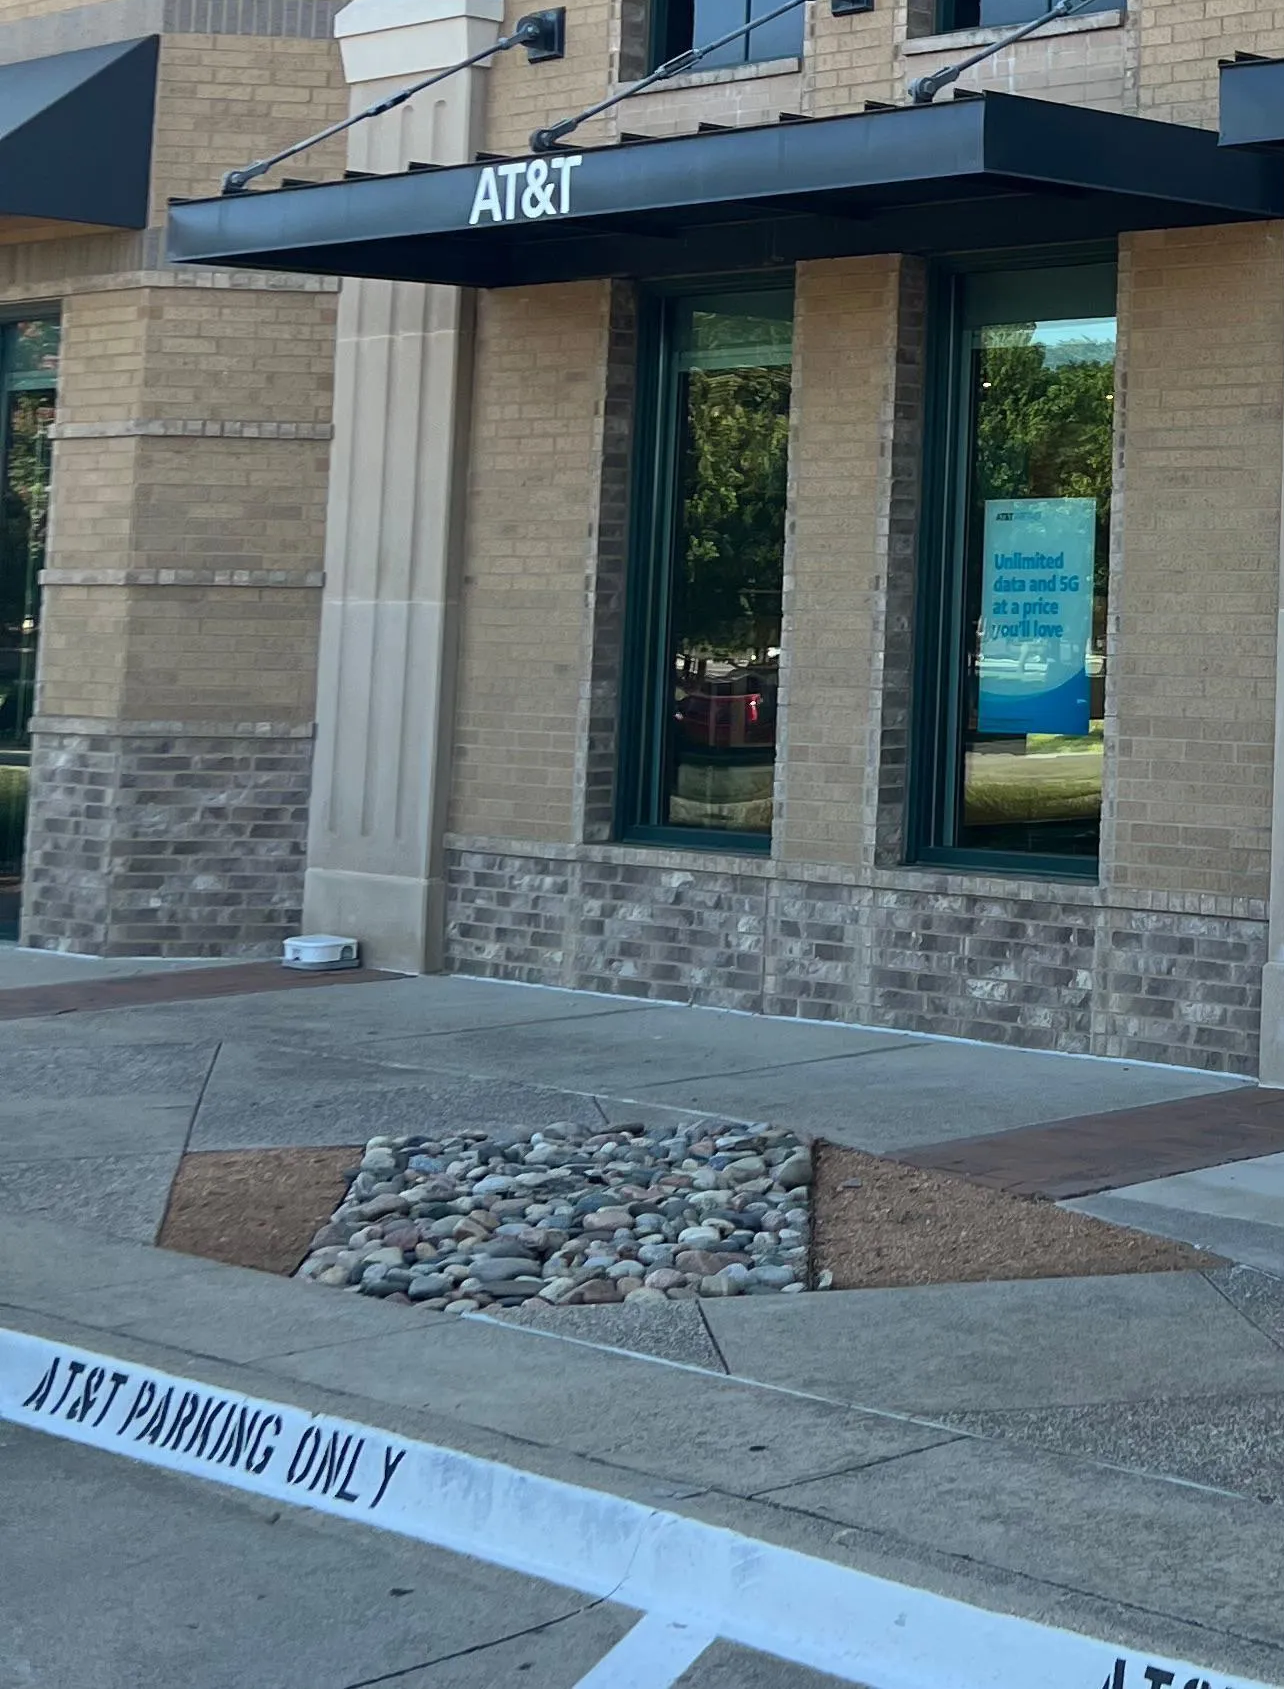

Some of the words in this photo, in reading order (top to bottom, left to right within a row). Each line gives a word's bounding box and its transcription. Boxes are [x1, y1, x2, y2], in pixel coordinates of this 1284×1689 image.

[468, 155, 583, 225] AT&T
[994, 551, 1064, 570] Unlimited
[993, 575, 1026, 592] data
[1029, 574, 1057, 592] and
[1059, 575, 1080, 592] 5G
[992, 600, 1008, 615] at
[1011, 601, 1020, 615] a
[1023, 597, 1059, 619] price
[992, 620, 1030, 640] you'll
[1034, 620, 1064, 638] love
[22, 1357, 130, 1428] AT&T
[116, 1379, 284, 1475] PARKING
[286, 1424, 407, 1510] ONLY
